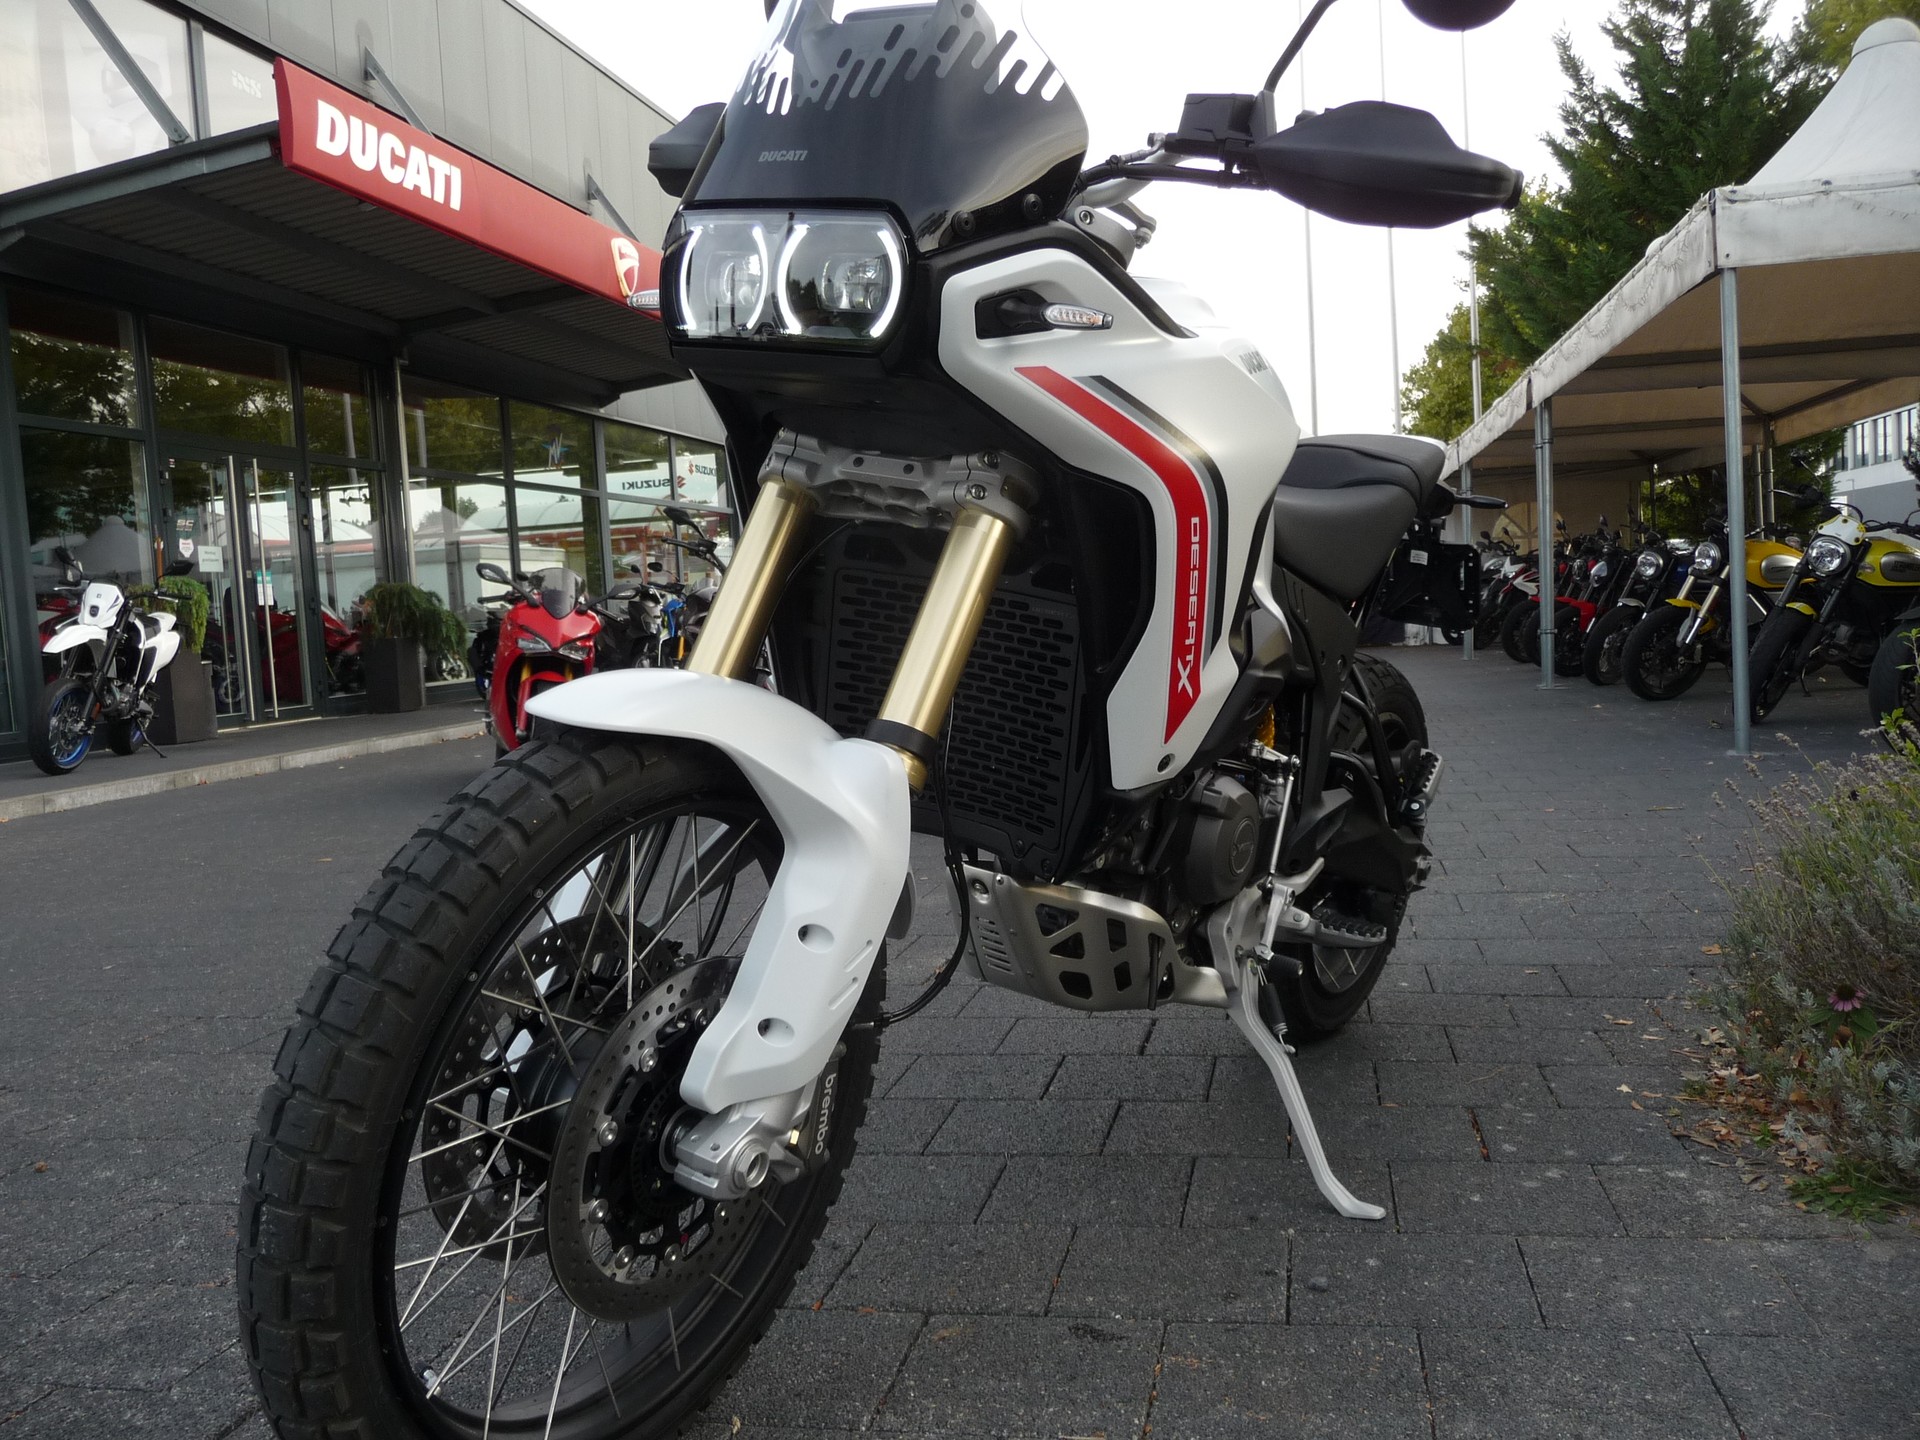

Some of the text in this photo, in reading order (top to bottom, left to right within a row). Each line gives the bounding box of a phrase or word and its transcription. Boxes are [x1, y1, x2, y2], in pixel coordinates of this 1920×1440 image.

[315, 98, 462, 212] DUCATI
[758, 150, 808, 162] DUCATI
[814, 1073, 837, 1155] brembo
